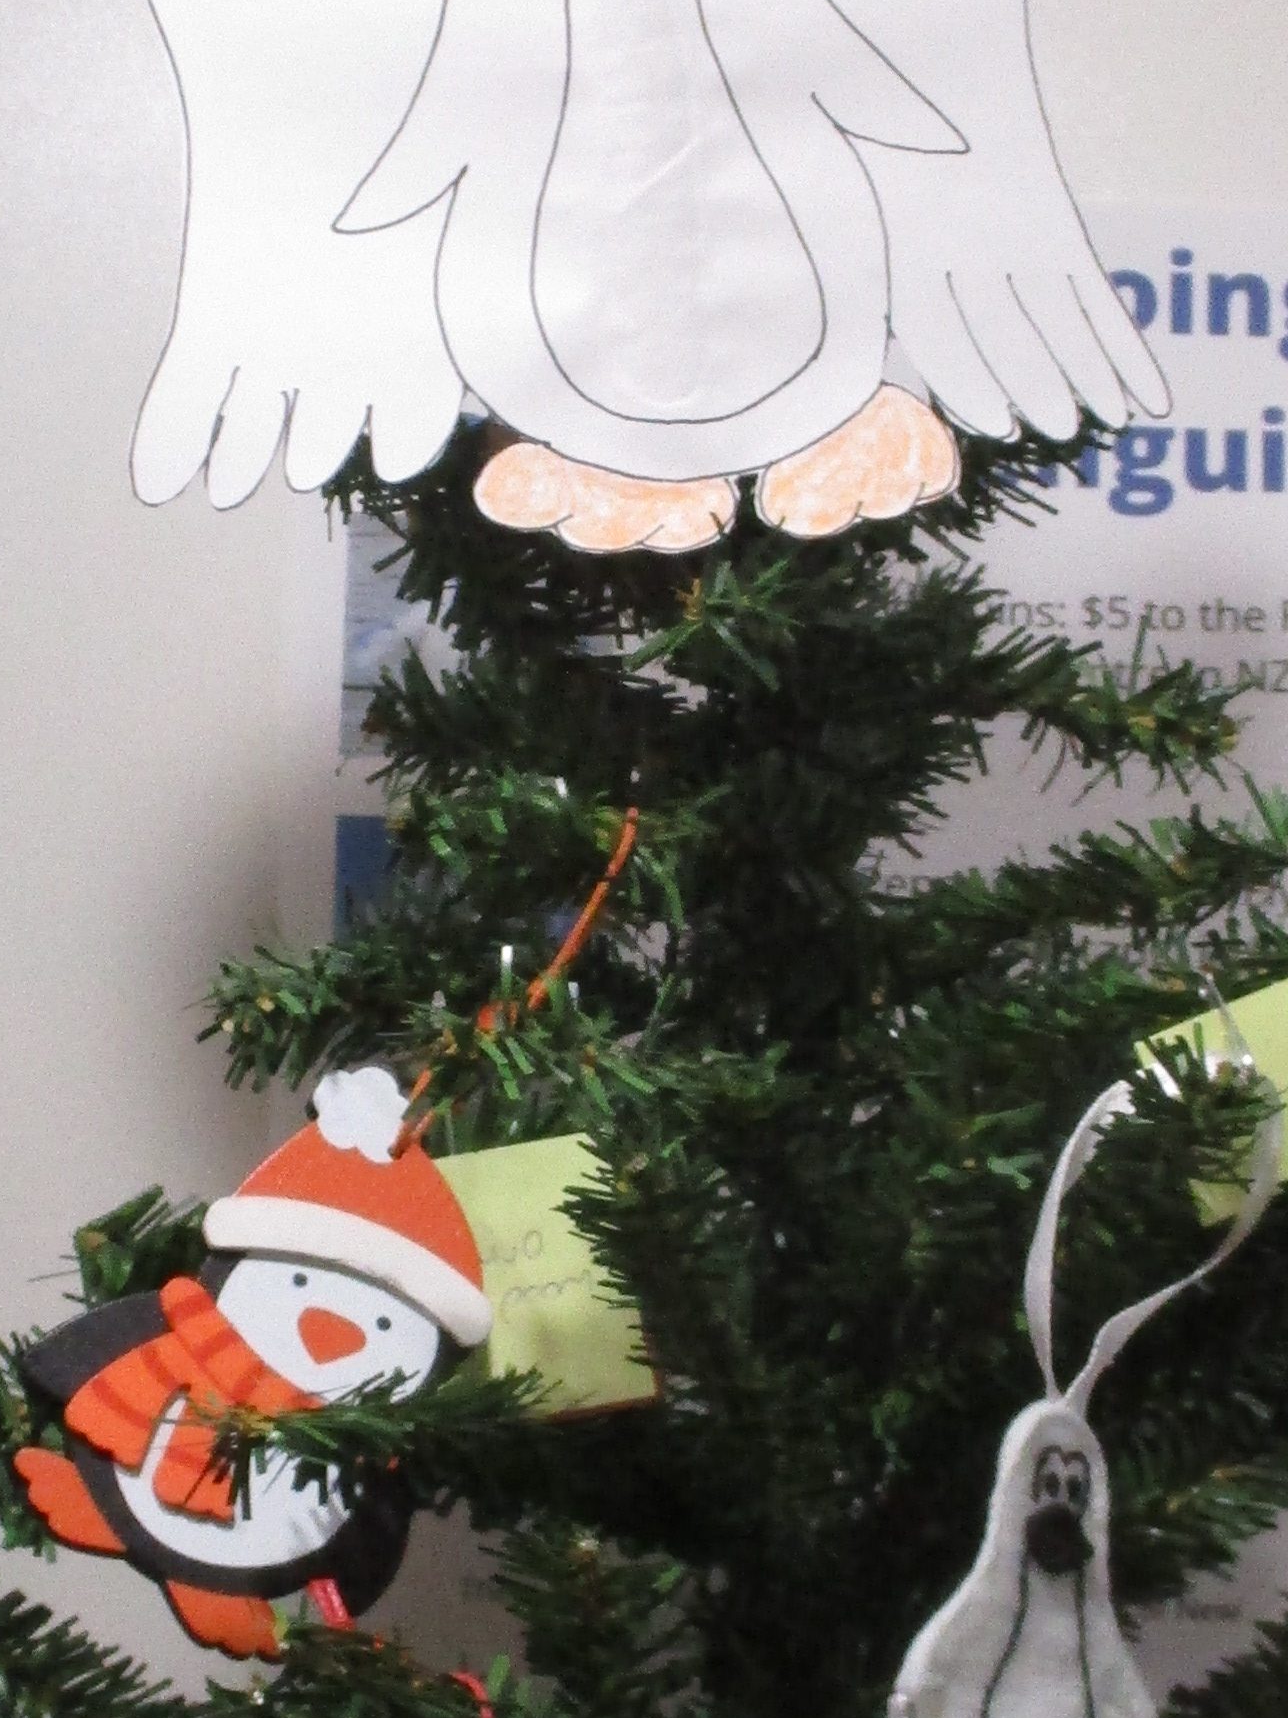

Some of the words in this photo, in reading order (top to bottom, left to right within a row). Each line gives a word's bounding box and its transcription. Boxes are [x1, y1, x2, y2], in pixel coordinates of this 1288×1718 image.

[1082, 596, 1130, 630] $5
[1144, 601, 1186, 631] to
[1199, 597, 1265, 633] the
